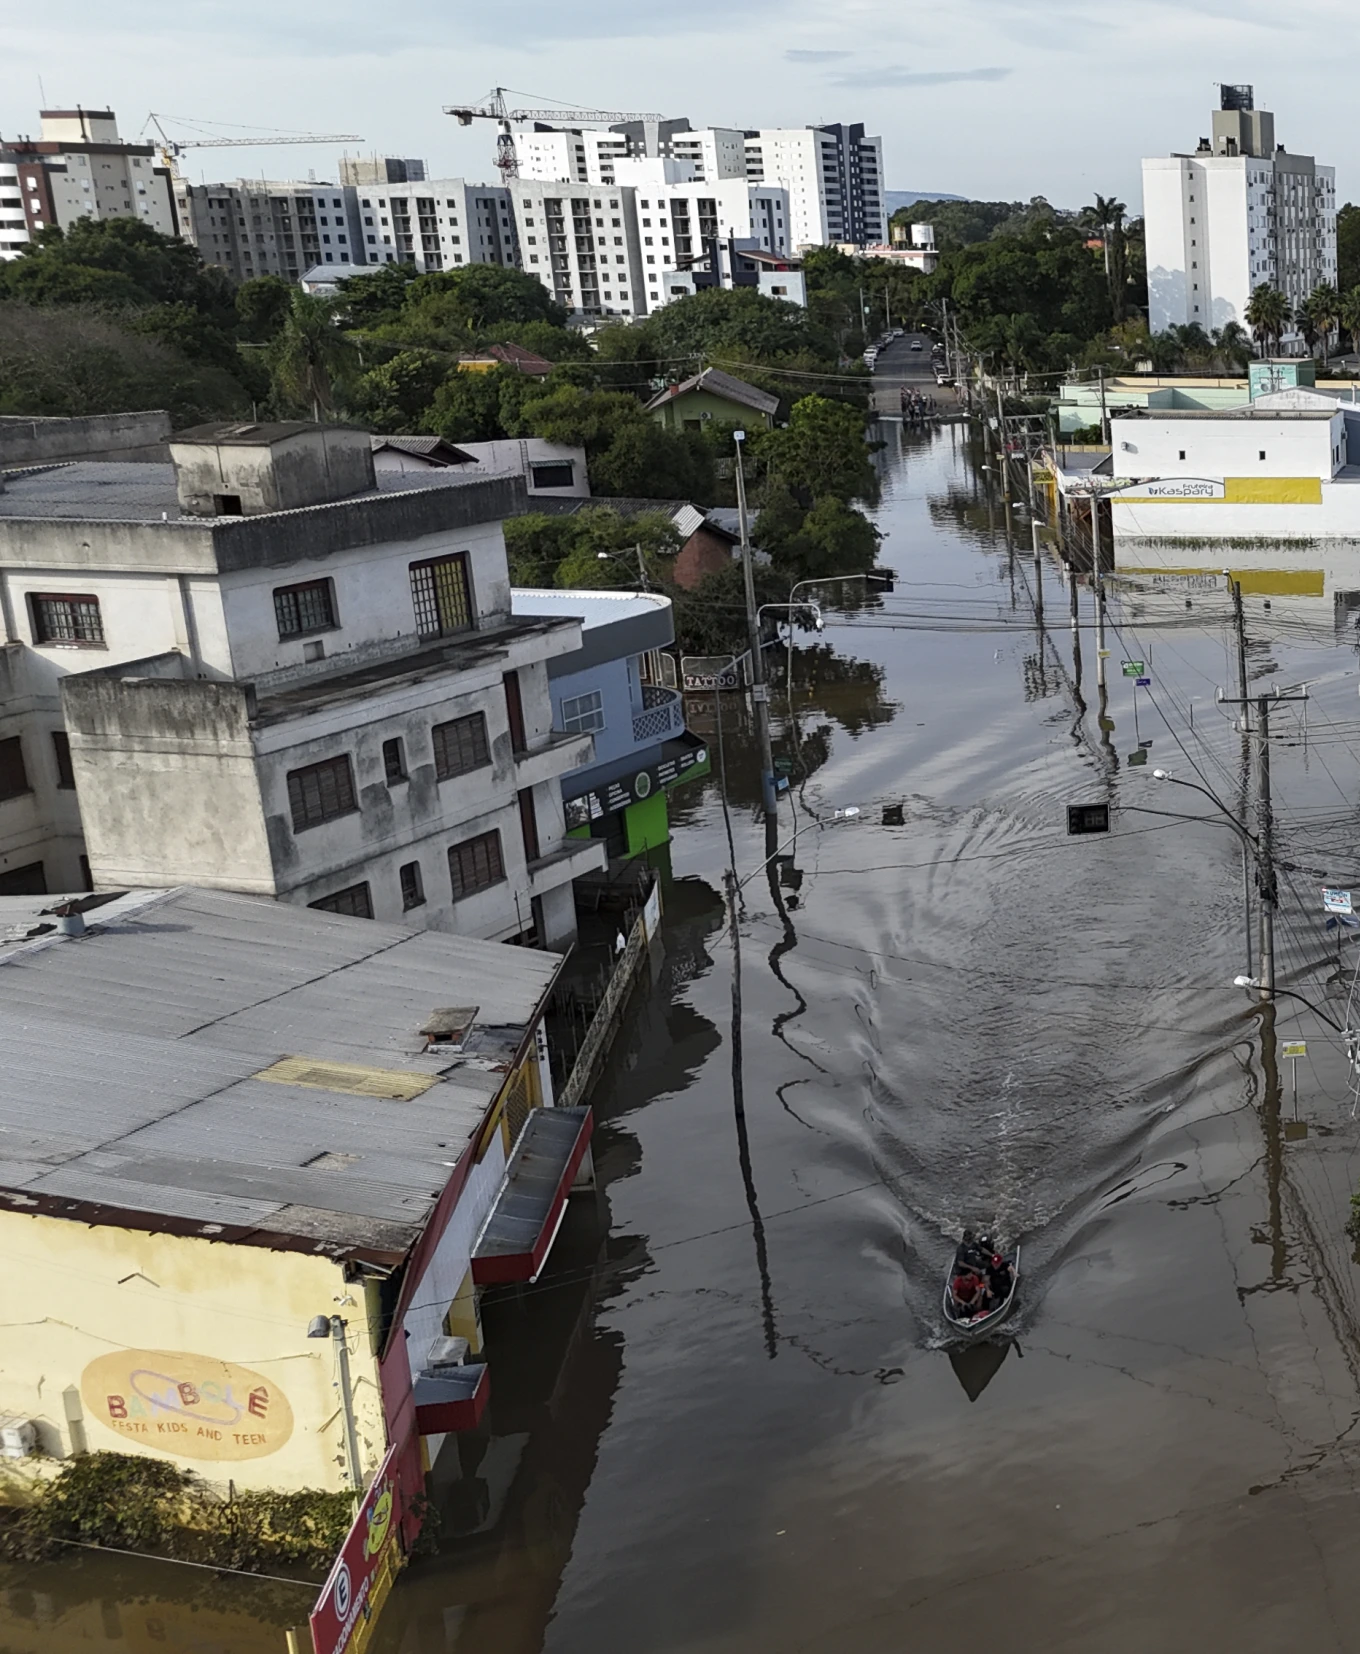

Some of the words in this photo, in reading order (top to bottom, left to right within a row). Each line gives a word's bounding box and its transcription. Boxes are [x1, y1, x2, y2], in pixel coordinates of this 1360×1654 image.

[1159, 486, 1214, 496] Kaspary
[686, 675, 735, 686] TATTOO
[107, 1382, 269, 1420] BAMBOLÊ
[111, 1419, 150, 1433] FESTA
[157, 1422, 188, 1433] KIDS
[196, 1426, 222, 1441] AND
[232, 1433, 267, 1445] TEEN
